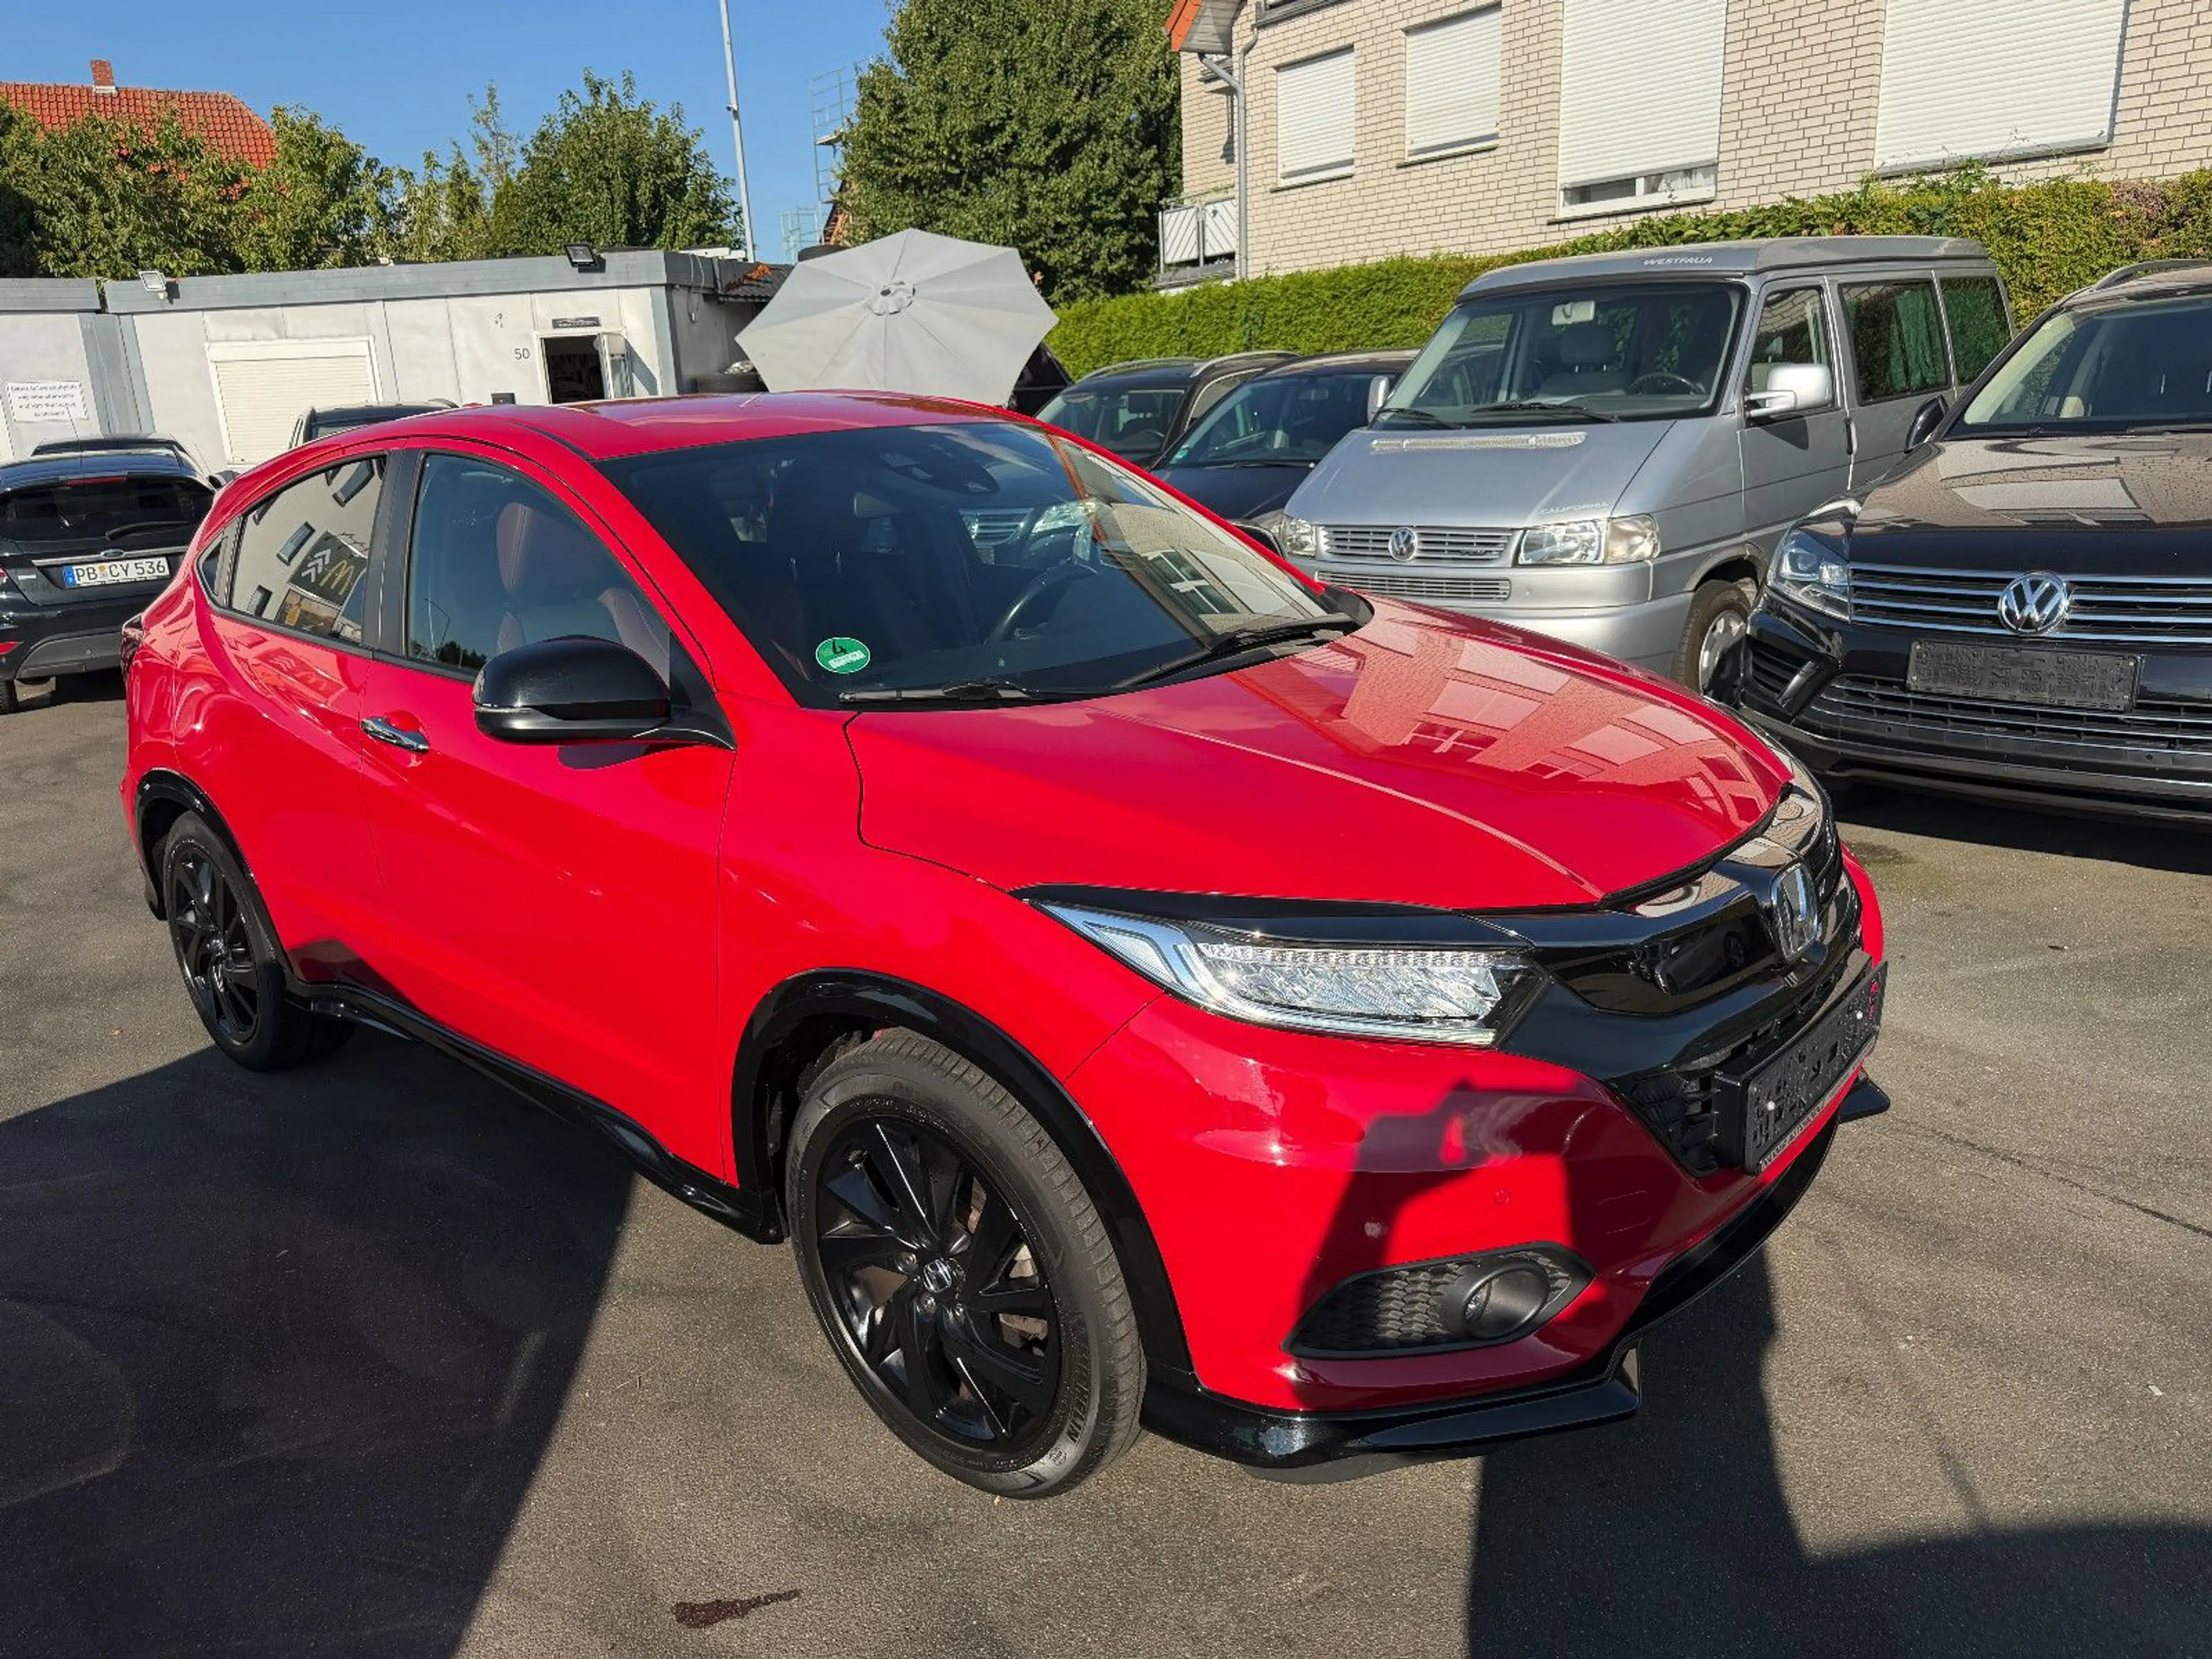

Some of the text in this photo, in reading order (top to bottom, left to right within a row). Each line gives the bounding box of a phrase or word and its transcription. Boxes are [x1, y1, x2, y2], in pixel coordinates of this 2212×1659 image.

[514, 348, 530, 359] 50
[75, 567, 97, 581] PB
[109, 563, 129, 577] CY
[135, 560, 166, 575] 536
